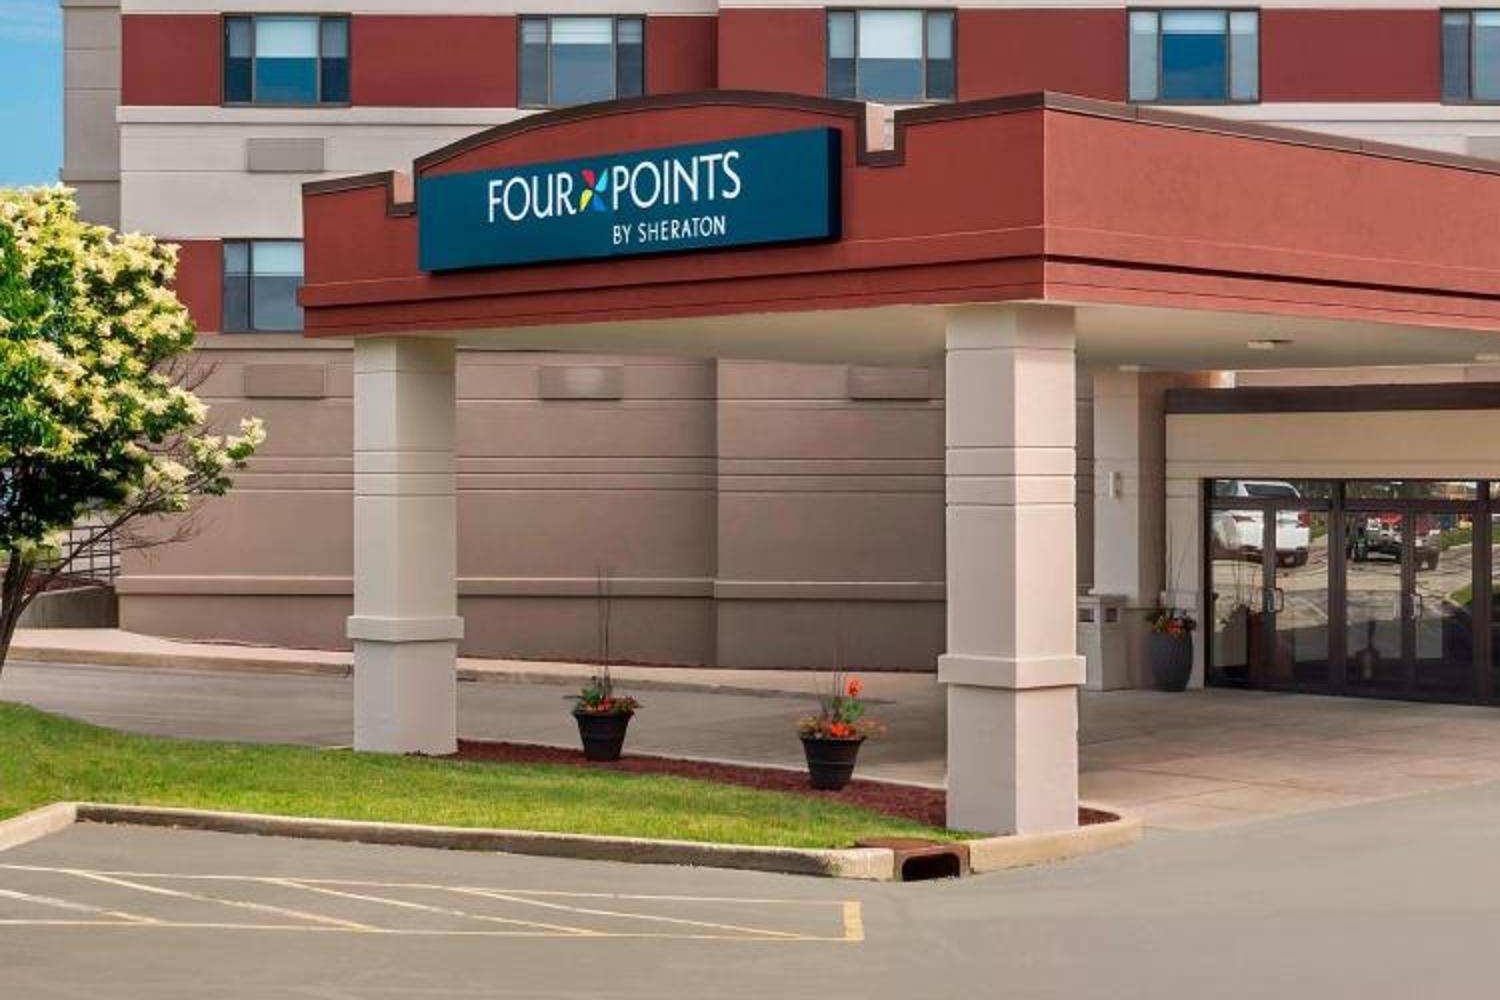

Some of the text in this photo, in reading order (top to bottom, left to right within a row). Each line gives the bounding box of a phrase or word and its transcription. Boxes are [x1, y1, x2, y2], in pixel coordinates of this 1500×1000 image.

[488, 150, 742, 223] FOUR POINTS
[612, 215, 727, 246] BY SHERATON
